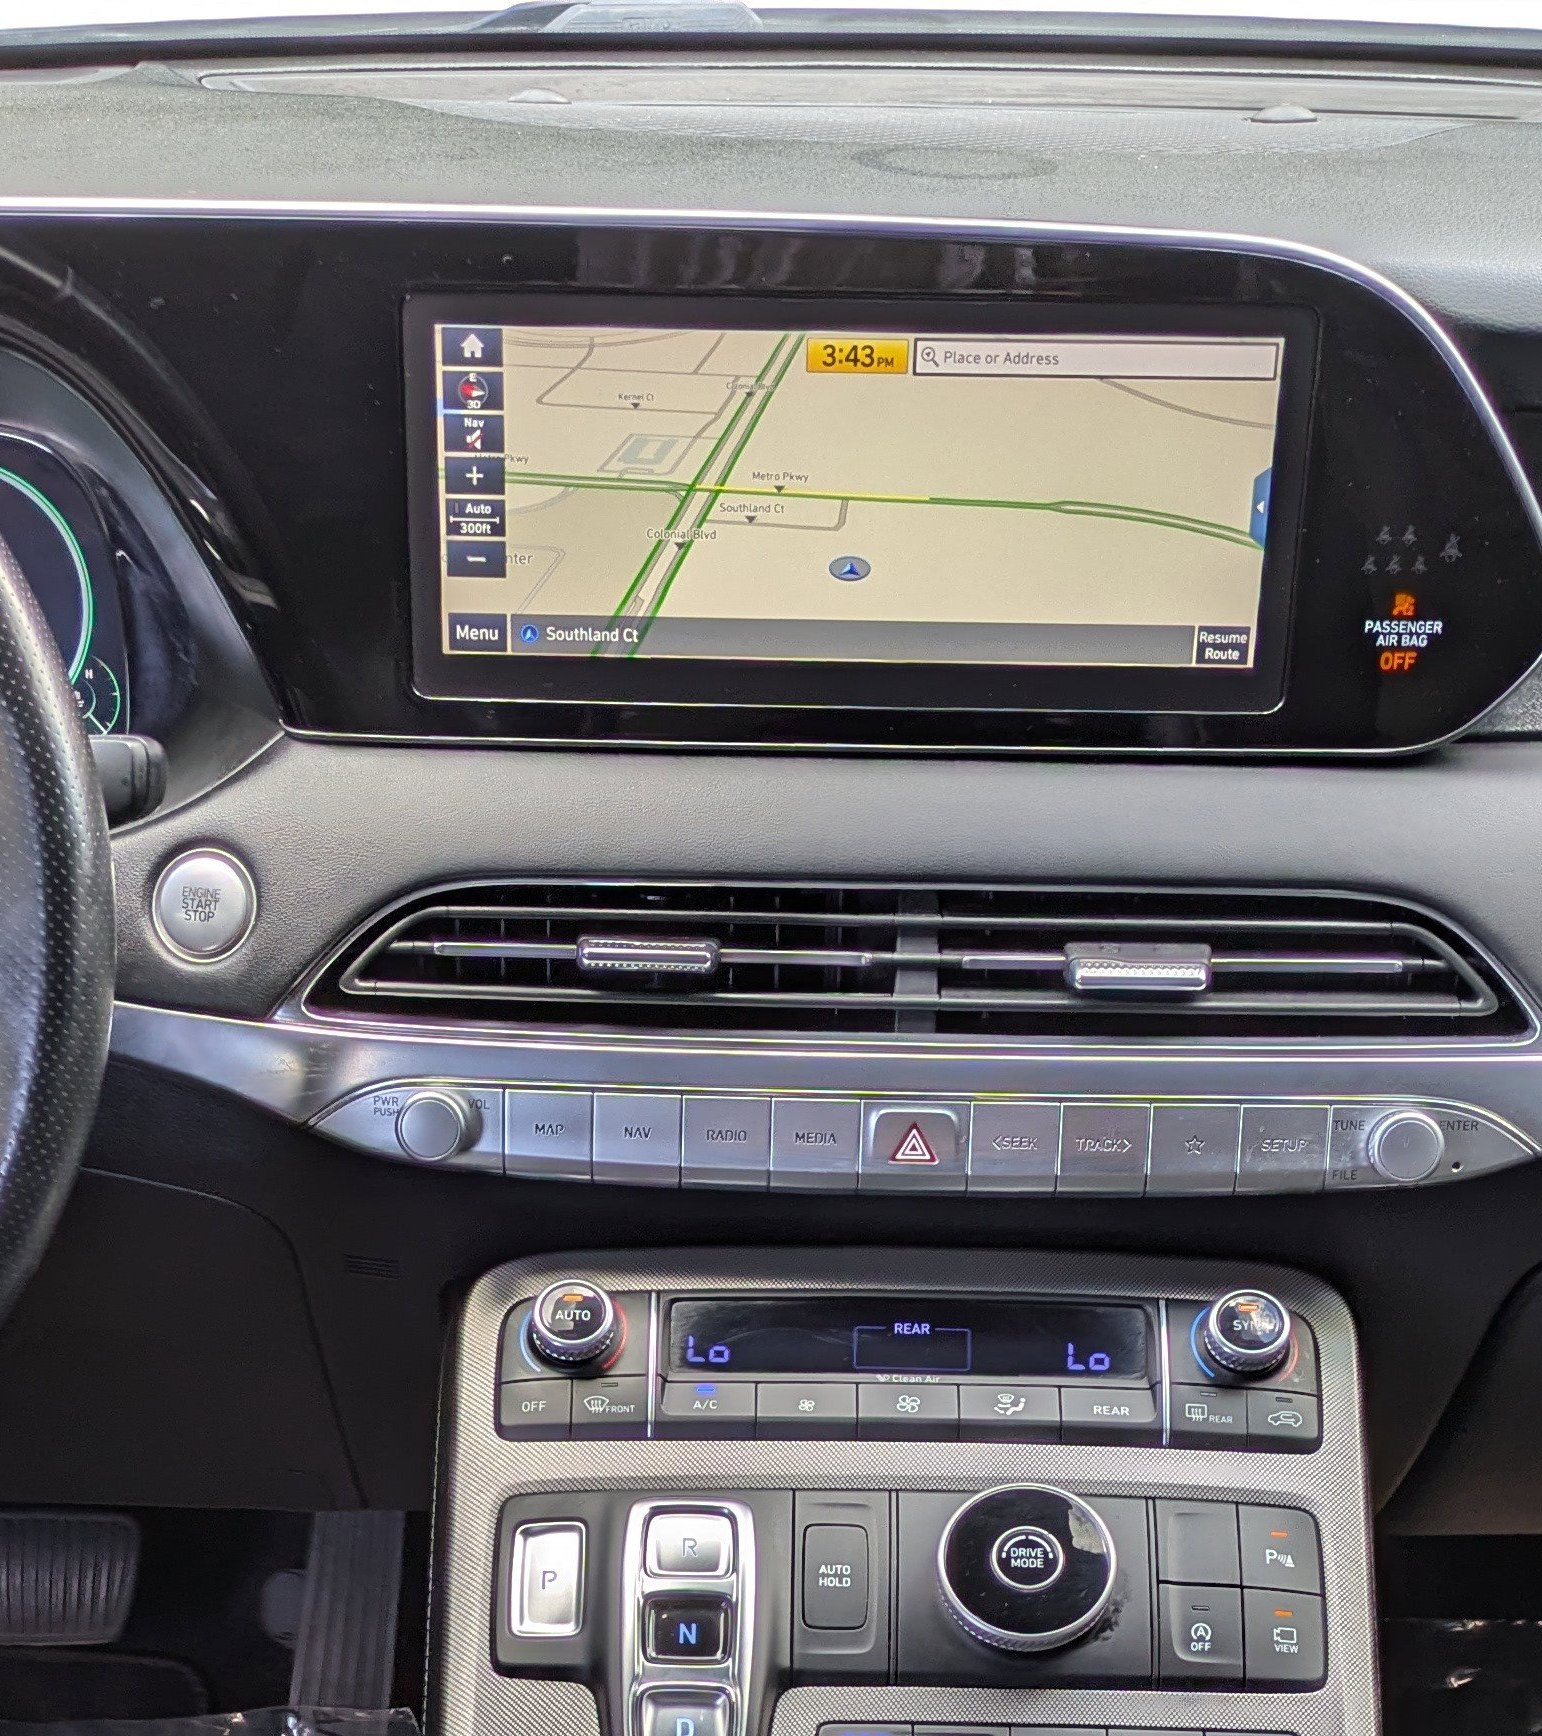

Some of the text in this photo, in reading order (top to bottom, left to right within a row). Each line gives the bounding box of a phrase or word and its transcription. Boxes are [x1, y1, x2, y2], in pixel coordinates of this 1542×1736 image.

[822, 344, 894, 368] 3:43 PM
[943, 350, 1059, 366] Place or Address
[467, 400, 481, 410] 3D
[464, 418, 484, 428] Nav
[752, 472, 808, 483] Metro Pkwy
[465, 503, 492, 514] Auto
[719, 503, 785, 514] Southland Ct
[460, 523, 491, 534] 300ft
[646, 529, 717, 540] Colonial Blvd
[456, 625, 499, 641] Menu
[1364, 620, 1444, 635] PASSENGER
[546, 626, 639, 643] Southland Ct
[1199, 631, 1248, 644] Resume
[1376, 634, 1428, 647] AIR BAG
[1204, 648, 1240, 660] Route
[1380, 651, 1417, 670] OFF
[182, 886, 221, 899] ENGINE
[181, 898, 220, 911] START
[184, 909, 215, 922] STOP
[373, 1096, 490, 1110] PWR VOL
[373, 1107, 400, 1117] PUSH
[534, 1123, 566, 1136] MAP
[1333, 1119, 1479, 1131] TUNE ENTER
[624, 1126, 652, 1140] NAV
[706, 1129, 748, 1143] RADIO
[795, 1132, 837, 1146] MEDIA
[1261, 1139, 1308, 1152] SETUP
[1332, 1169, 1357, 1181] FILE
[555, 1309, 592, 1322] AUTO
[894, 1323, 931, 1335] REAR
[1233, 1319, 1268, 1331] SYN
[686, 1335, 730, 1364] Lo
[1067, 1342, 1111, 1371] Lo
[892, 1374, 941, 1384] Clean Air
[521, 1400, 546, 1413] OFF
[605, 1403, 635, 1415] FRONT
[693, 1399, 718, 1411] A/C
[1093, 1404, 1129, 1417] REAR
[1209, 1414, 1233, 1424] REAR
[682, 1538, 698, 1557] R
[1010, 1546, 1045, 1558] DRIVE
[1010, 1557, 1045, 1569] MODE
[819, 1564, 851, 1576] AUTO
[541, 1570, 557, 1590] P
[819, 1576, 851, 1588] HOLD
[678, 1622, 698, 1645] N
[1190, 1641, 1211, 1651] OFF
[1274, 1643, 1299, 1654] VIEW
